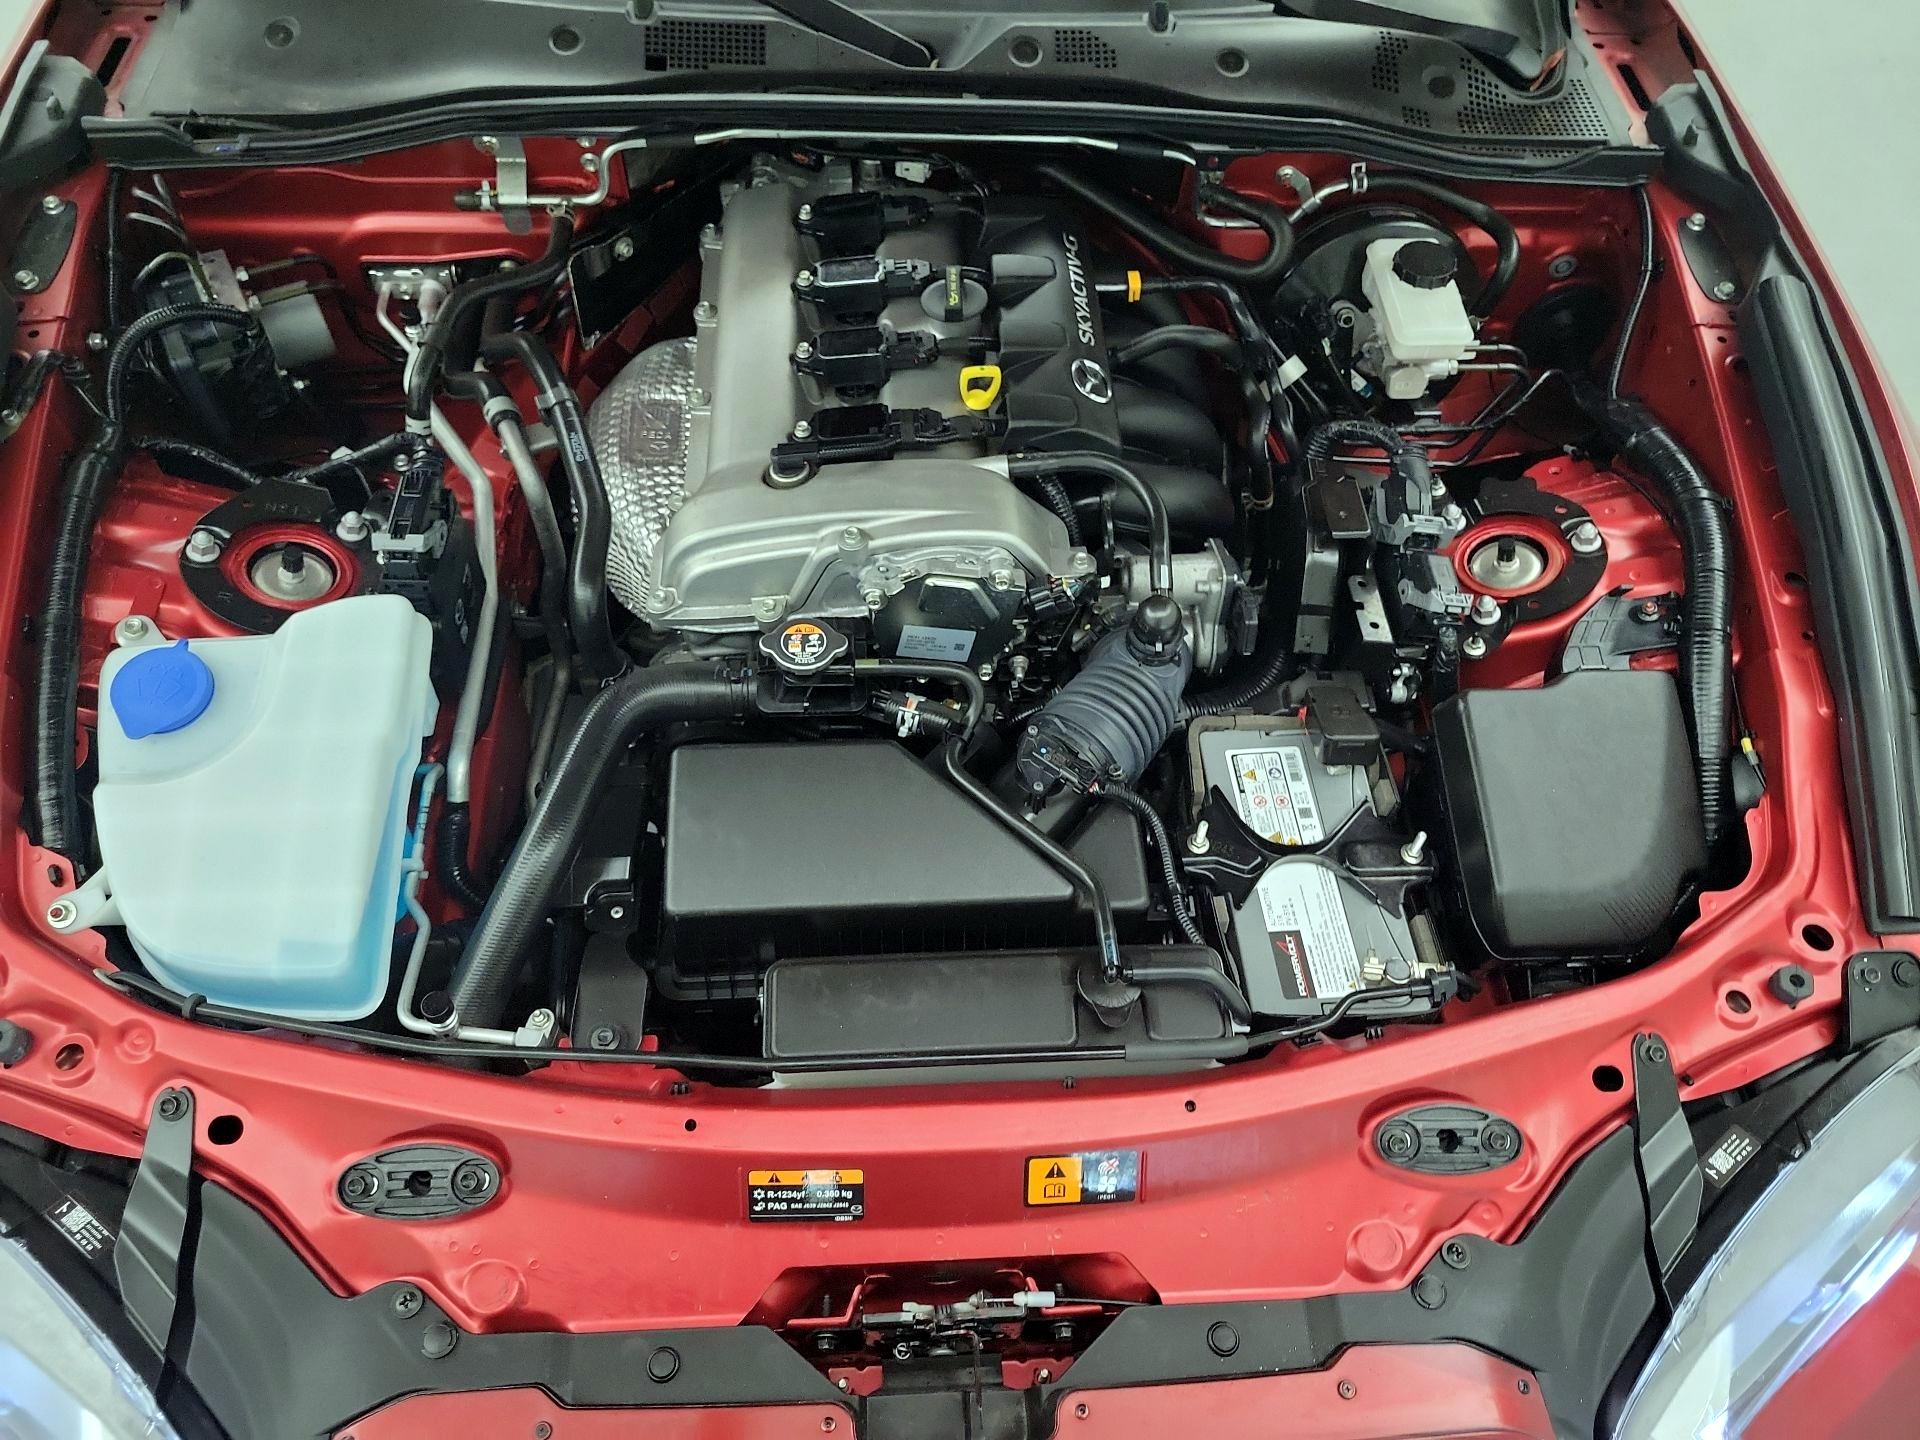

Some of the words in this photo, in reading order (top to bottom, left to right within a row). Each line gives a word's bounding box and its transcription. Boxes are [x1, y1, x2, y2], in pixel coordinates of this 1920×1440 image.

[1063, 232, 1095, 347] SKYACTIV-G
[1261, 887, 1276, 926] AUTOMOTIVE
[1285, 934, 1307, 997] POWERVOLT
[767, 1201, 787, 1210] PAG
[841, 1189, 853, 1199] kg
